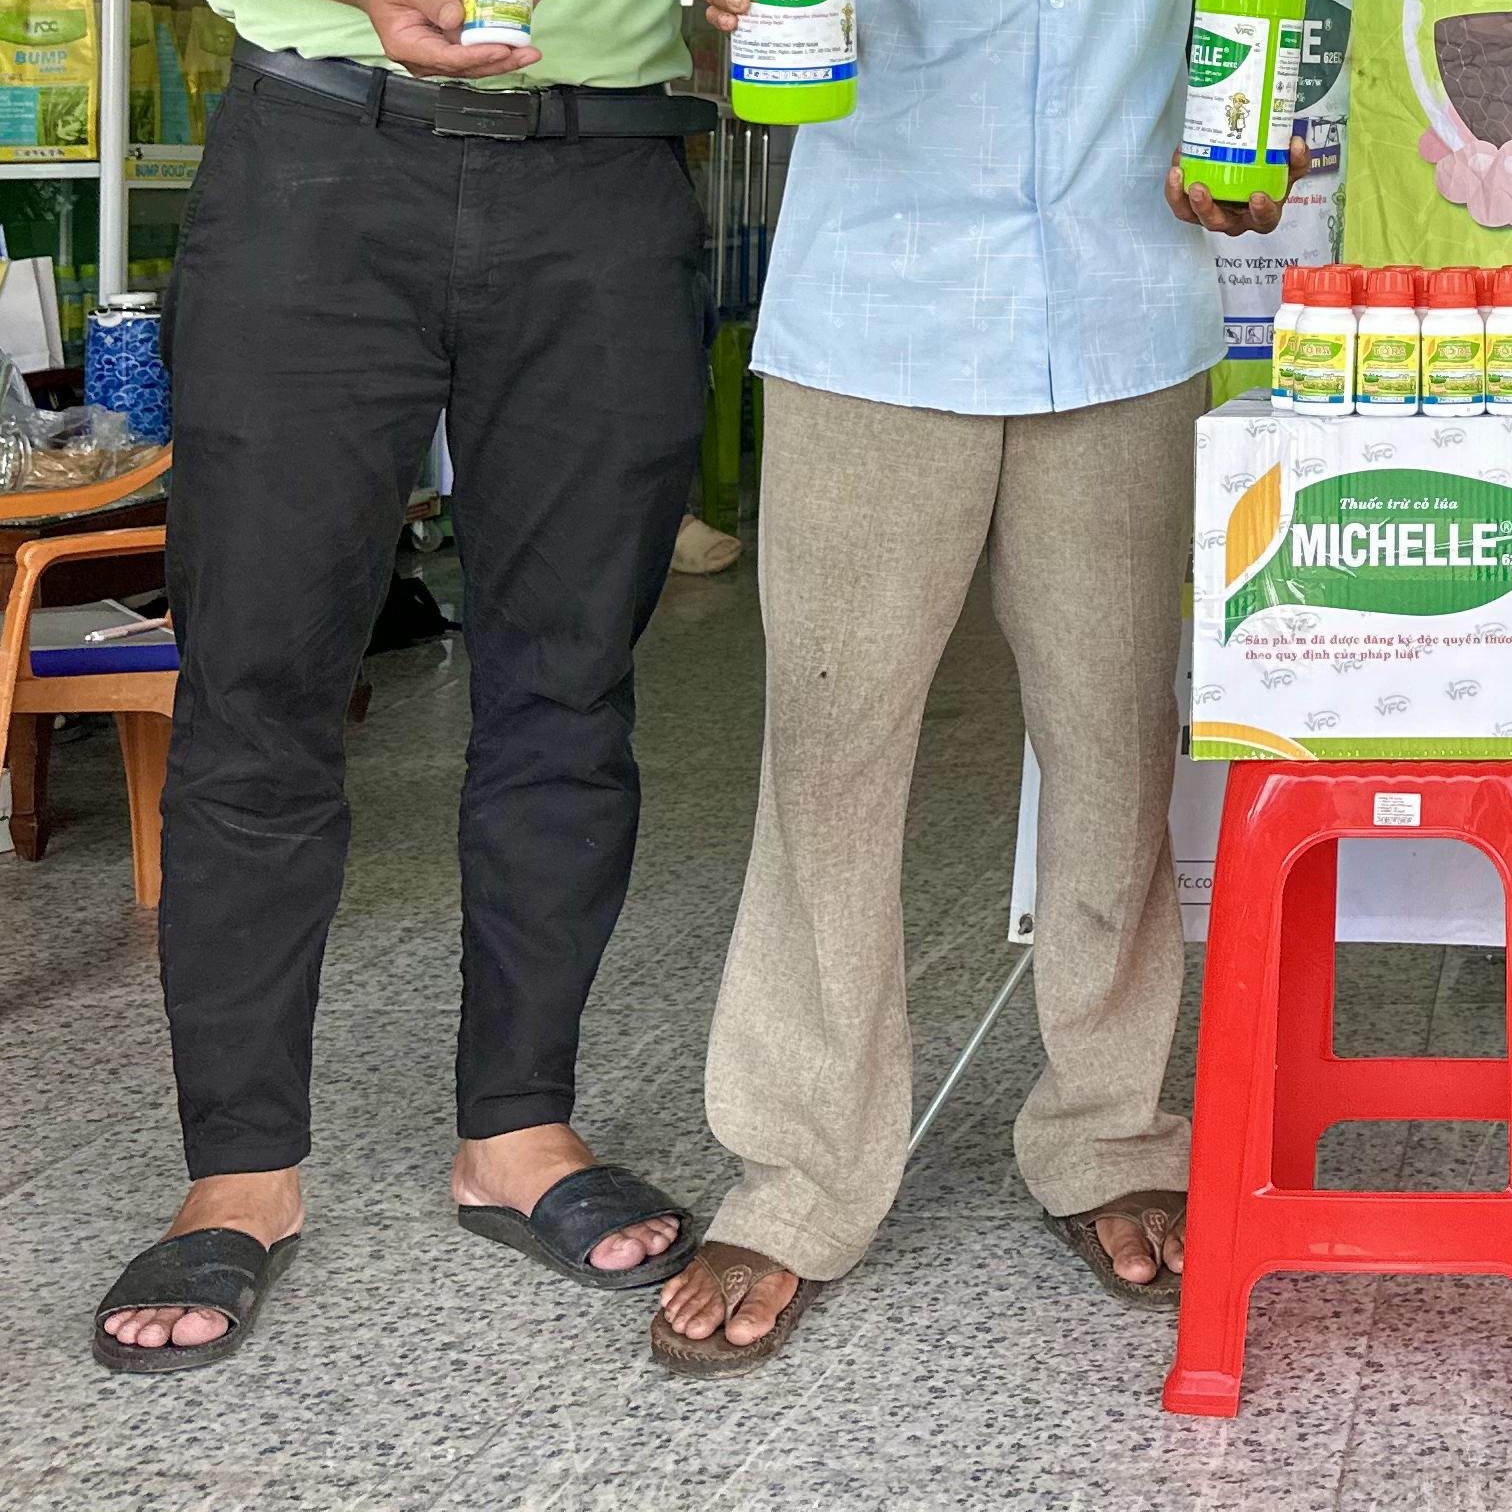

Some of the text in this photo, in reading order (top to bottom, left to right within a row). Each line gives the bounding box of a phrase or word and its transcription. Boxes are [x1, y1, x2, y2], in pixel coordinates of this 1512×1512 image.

[15, 50, 68, 65] BUMP
[1246, 254, 1274, 271] VIỆT
[1339, 496, 1459, 511] Thuốc trừ cỏ lúa
[1245, 634, 1269, 646] Sản
[1310, 634, 1326, 646] đã
[1330, 634, 1360, 648] được
[1276, 651, 1298, 663] quy
[1302, 649, 1330, 662] định
[1334, 650, 1357, 661] của
[1361, 650, 1392, 663] pháp
[1395, 648, 1420, 662] luật
